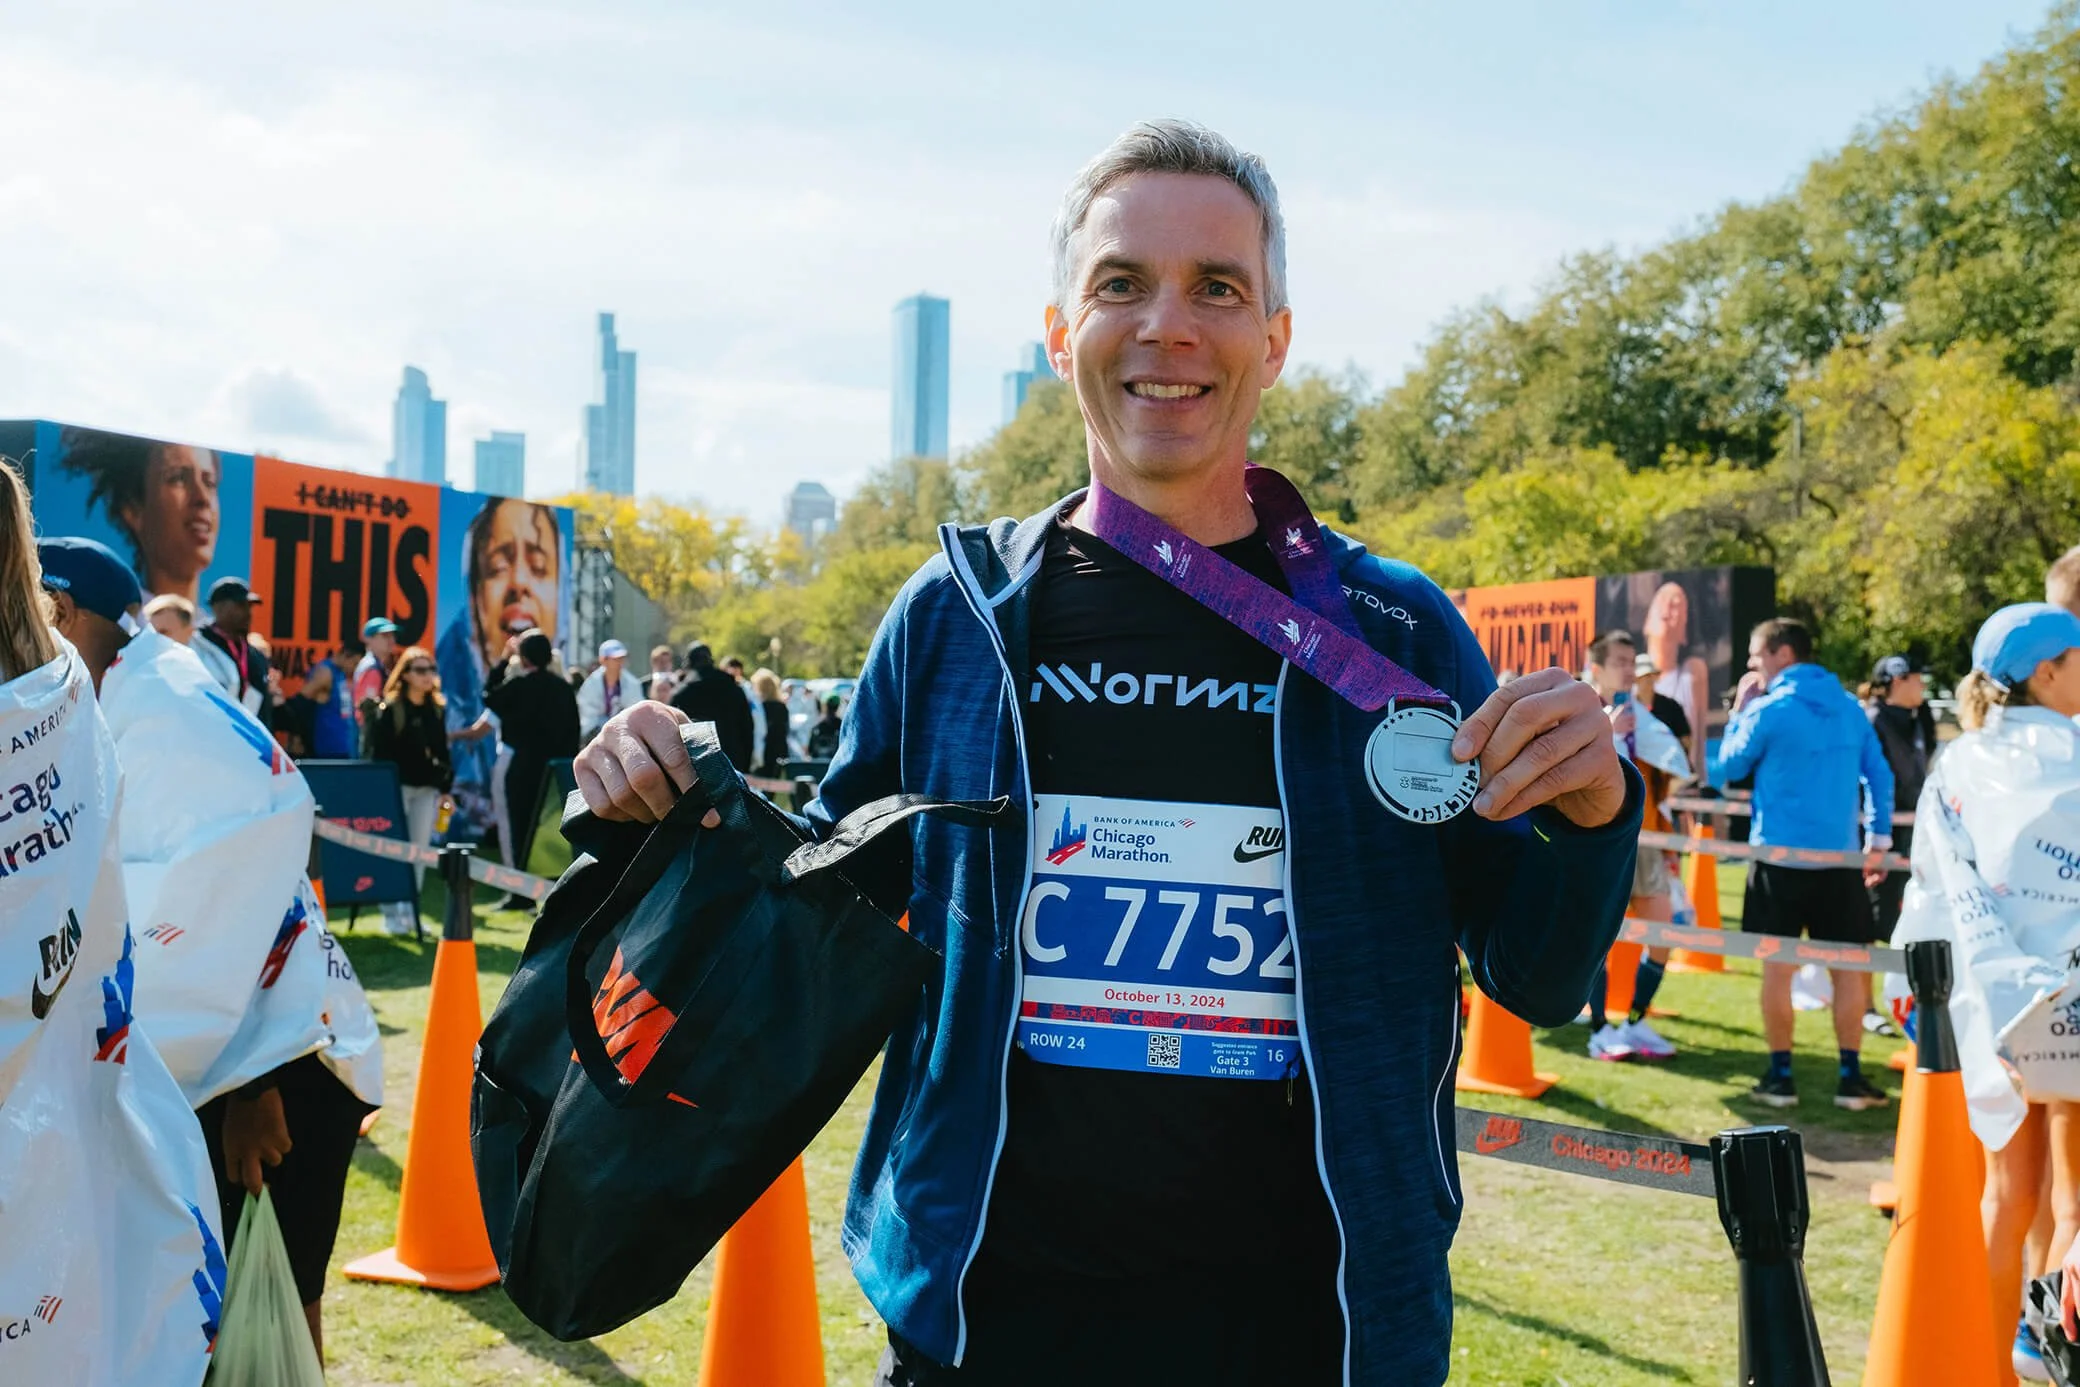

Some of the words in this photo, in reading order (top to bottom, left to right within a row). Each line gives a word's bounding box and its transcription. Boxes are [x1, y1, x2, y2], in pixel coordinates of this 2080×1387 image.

[263, 506, 431, 647] THIS
[1094, 816, 1119, 824] BANK
[1121, 817, 1132, 825] OF
[1134, 819, 1176, 828] AMERICA
[1092, 828, 1156, 848] Chicago
[1021, 881, 1071, 963] C
[1103, 886, 1295, 979] 7752
[1105, 988, 1160, 1004] October
[1166, 992, 1185, 1007] 13,
[1190, 994, 1225, 1008] 2024
[1030, 1032, 1063, 1048] ROW
[1067, 1036, 1086, 1050] 24
[1217, 1055, 1240, 1066] Gate
[1243, 1056, 1249, 1066] 3
[1267, 1049, 1284, 1063] 16
[1210, 1065, 1227, 1075] Van
[1230, 1066, 1255, 1076] Buren
[1552, 1133, 1631, 1171] Chicago
[1635, 1147, 1691, 1177] 2024
